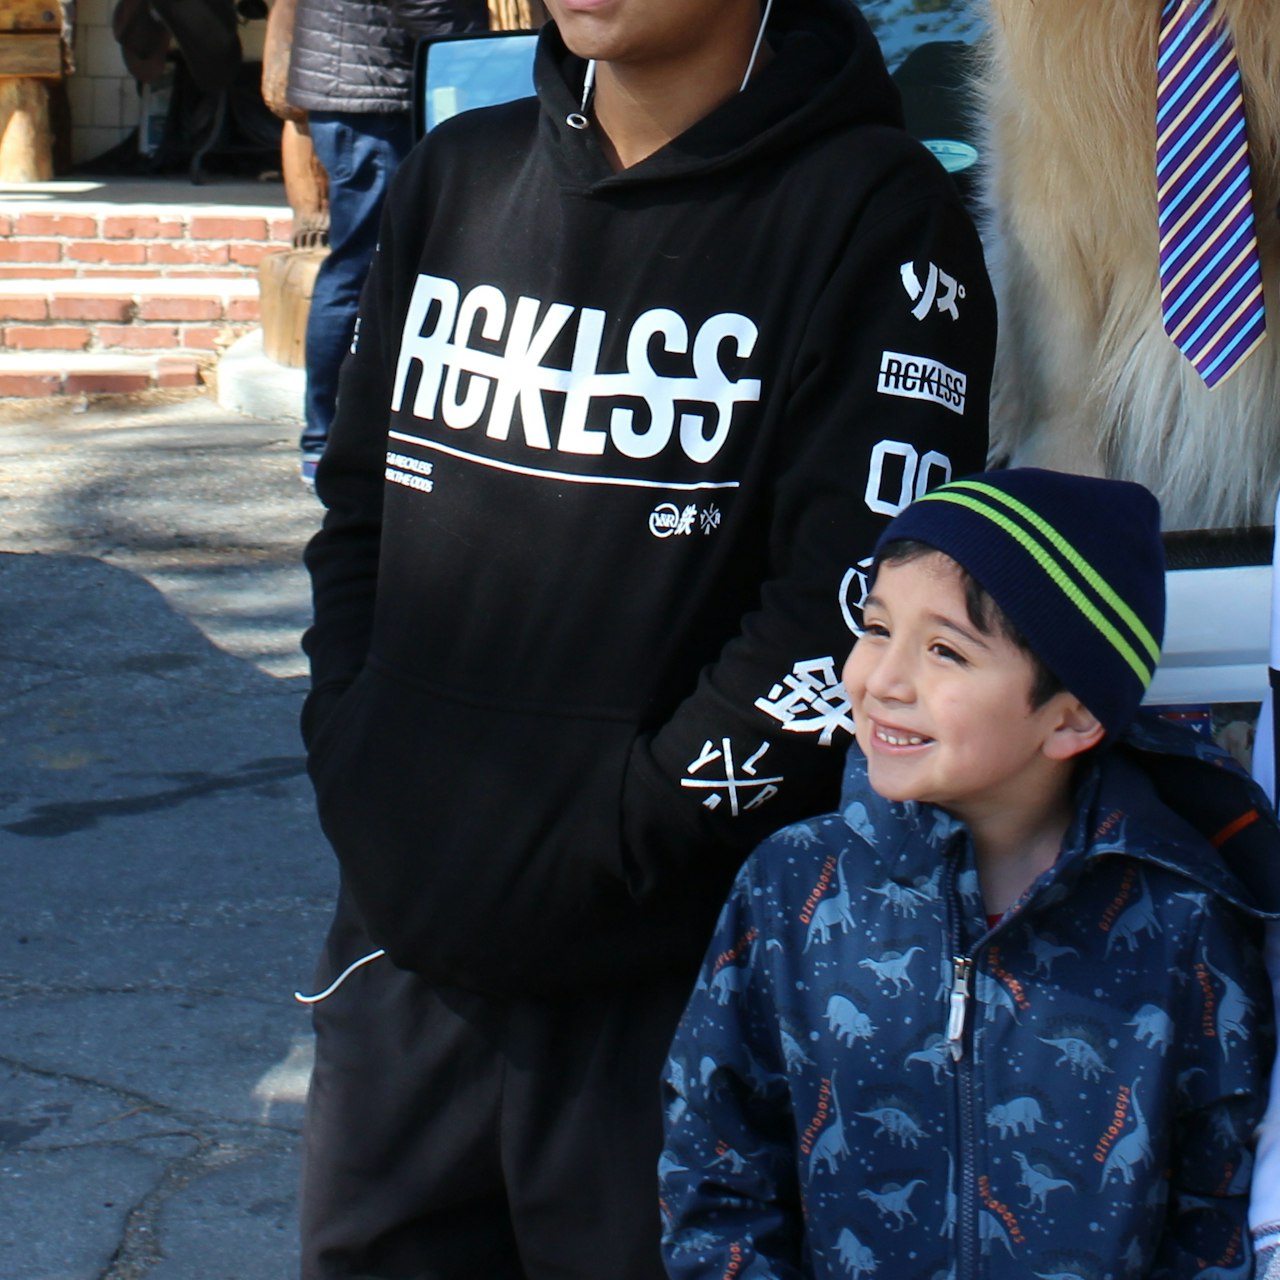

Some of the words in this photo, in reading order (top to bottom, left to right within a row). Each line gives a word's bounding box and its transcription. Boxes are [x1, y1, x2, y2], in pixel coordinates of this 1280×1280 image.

[390, 273, 762, 463] RCKLSS
[881, 358, 965, 407] RCKLSS
[800, 1077, 833, 1155] DIPLODOCUS
[1093, 1085, 1131, 1162] DIPLODOCUS
